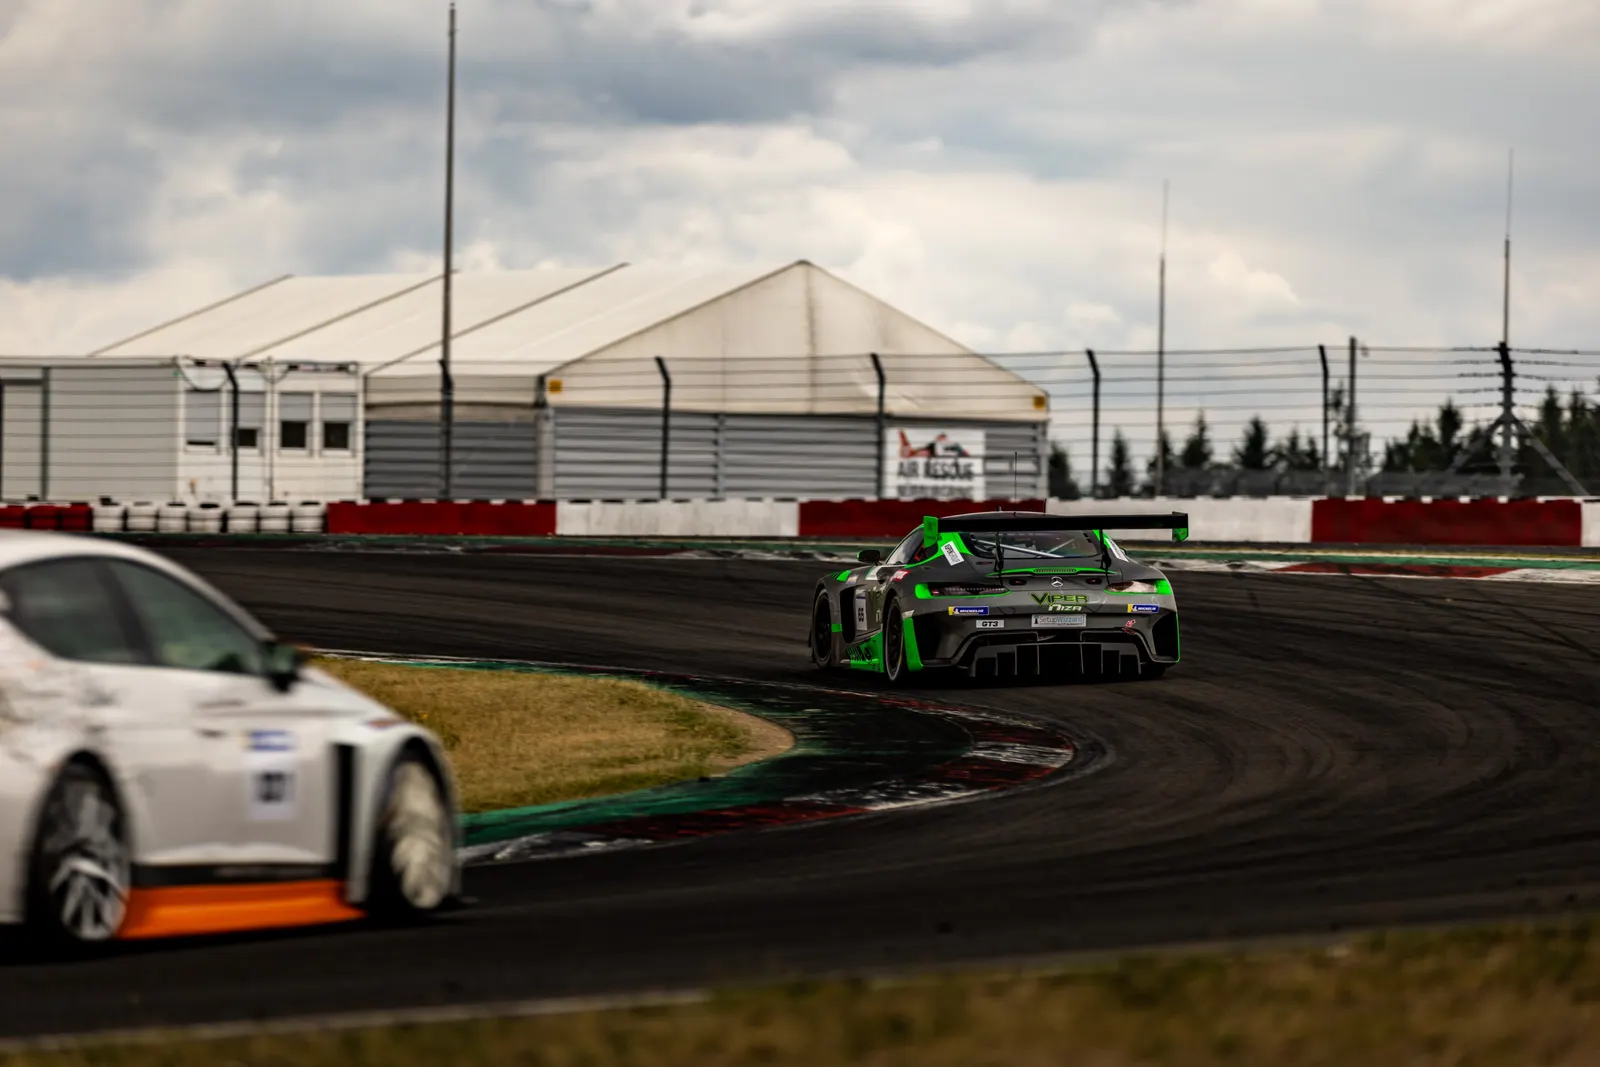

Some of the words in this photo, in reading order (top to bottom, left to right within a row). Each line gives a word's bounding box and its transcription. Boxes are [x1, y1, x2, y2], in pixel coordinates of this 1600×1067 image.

[898, 461, 919, 478] AIR
[924, 460, 974, 480] RESCUE
[1028, 592, 1087, 607] VIPER
[1039, 615, 1083, 623] SetupWizzard
